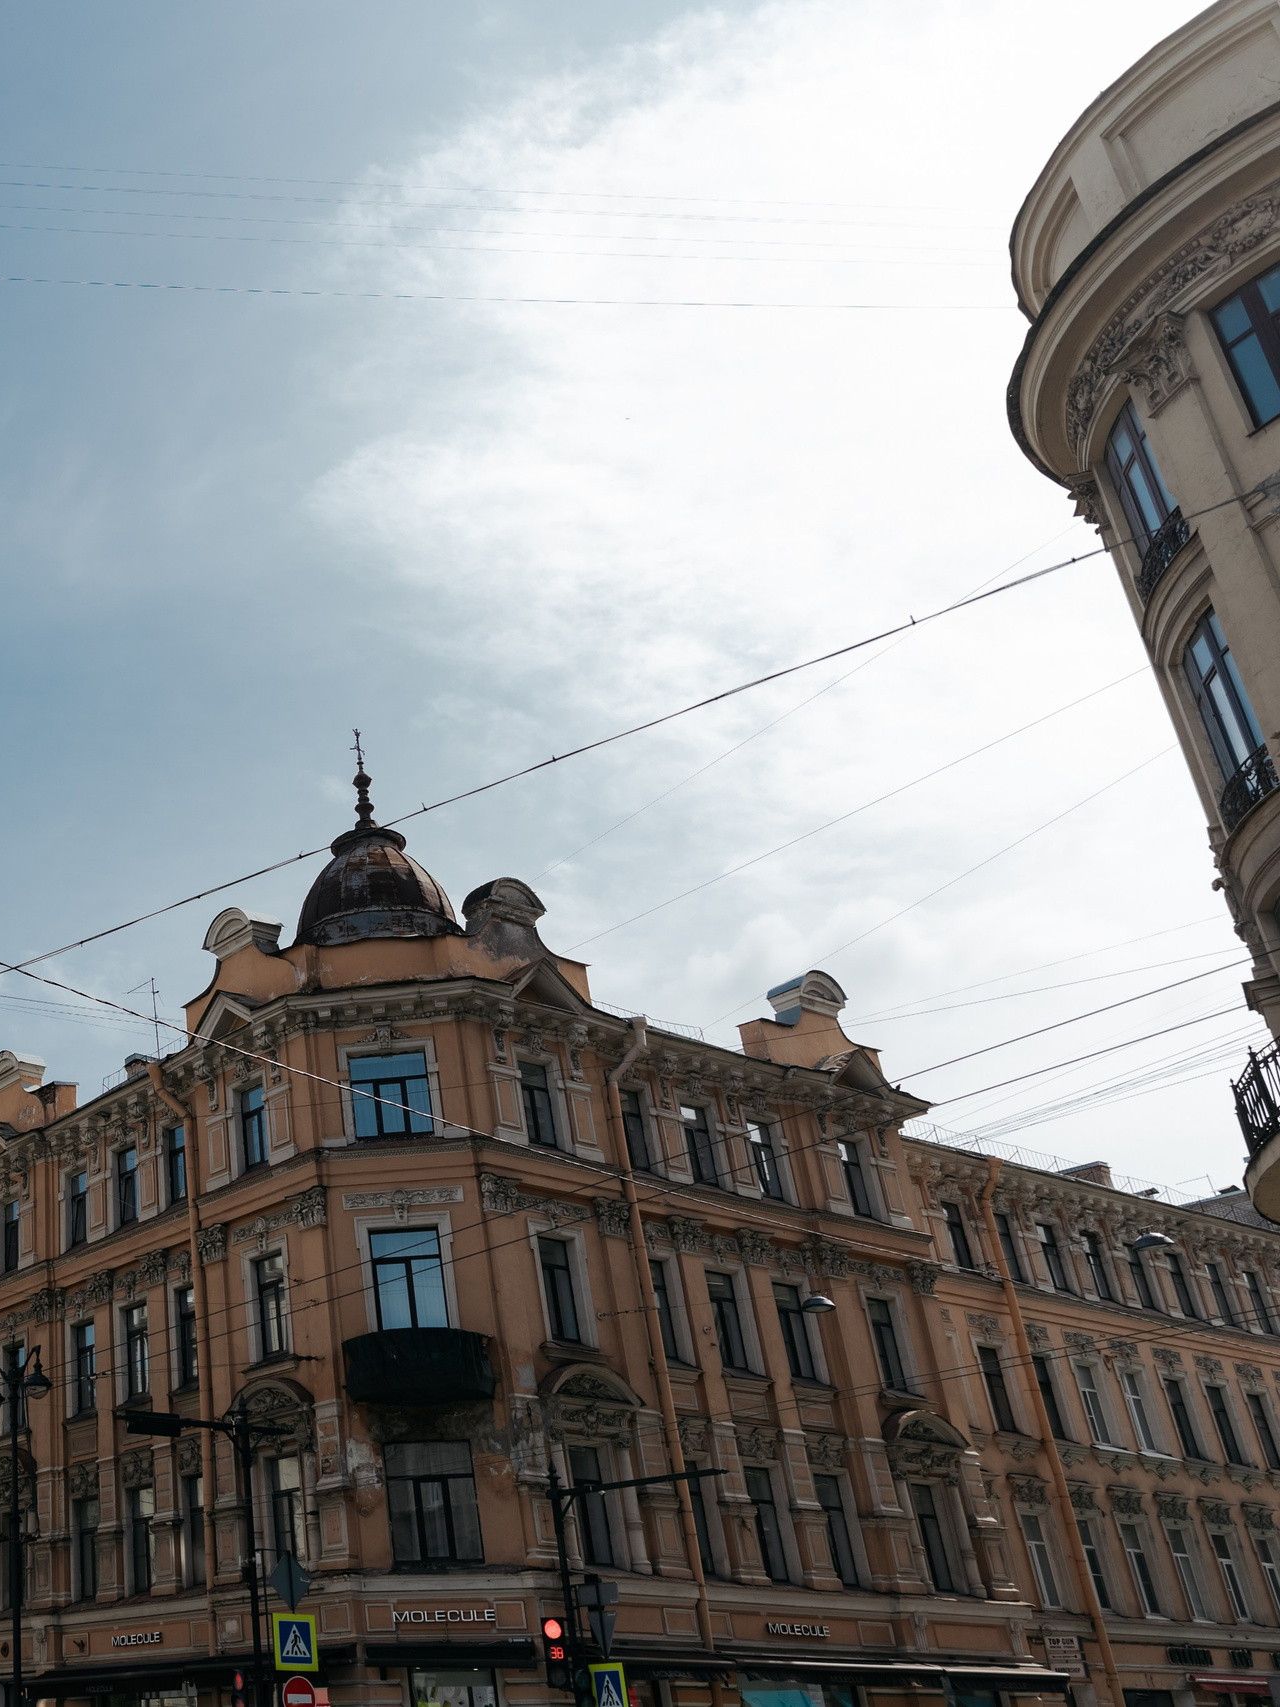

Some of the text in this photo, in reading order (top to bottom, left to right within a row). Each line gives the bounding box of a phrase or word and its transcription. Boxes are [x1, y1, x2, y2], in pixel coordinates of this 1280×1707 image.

[393, 1609, 496, 1623] MOLECULE
[767, 1622, 831, 1637] MOLECULE
[111, 1631, 162, 1647] MOLECULE
[550, 1646, 565, 1660] 38
[652, 1670, 693, 1679] MOLECULE
